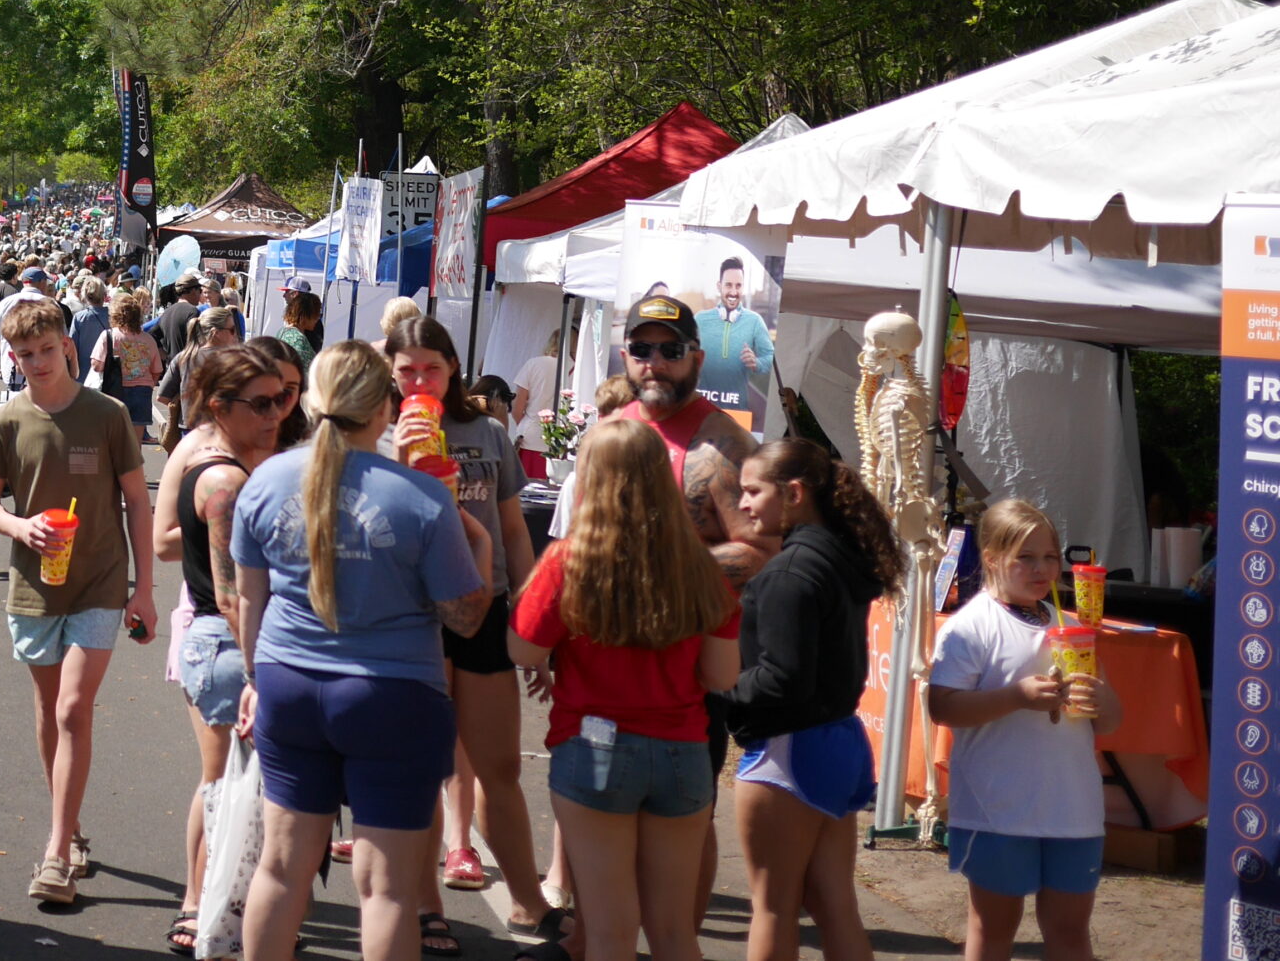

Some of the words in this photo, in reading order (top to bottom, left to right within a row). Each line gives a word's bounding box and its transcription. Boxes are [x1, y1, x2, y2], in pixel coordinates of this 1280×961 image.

[134, 80, 147, 143] CUTCO
[385, 181, 436, 194] SPEED
[390, 197, 430, 209] LMIT
[231, 208, 305, 222] CUTCO
[1248, 303, 1278, 317] Living
[1248, 332, 1255, 340] a
[1256, 331, 1274, 342] full,
[1246, 375, 1280, 402] FR
[720, 391, 740, 404] LIFE
[1246, 413, 1280, 440] SC
